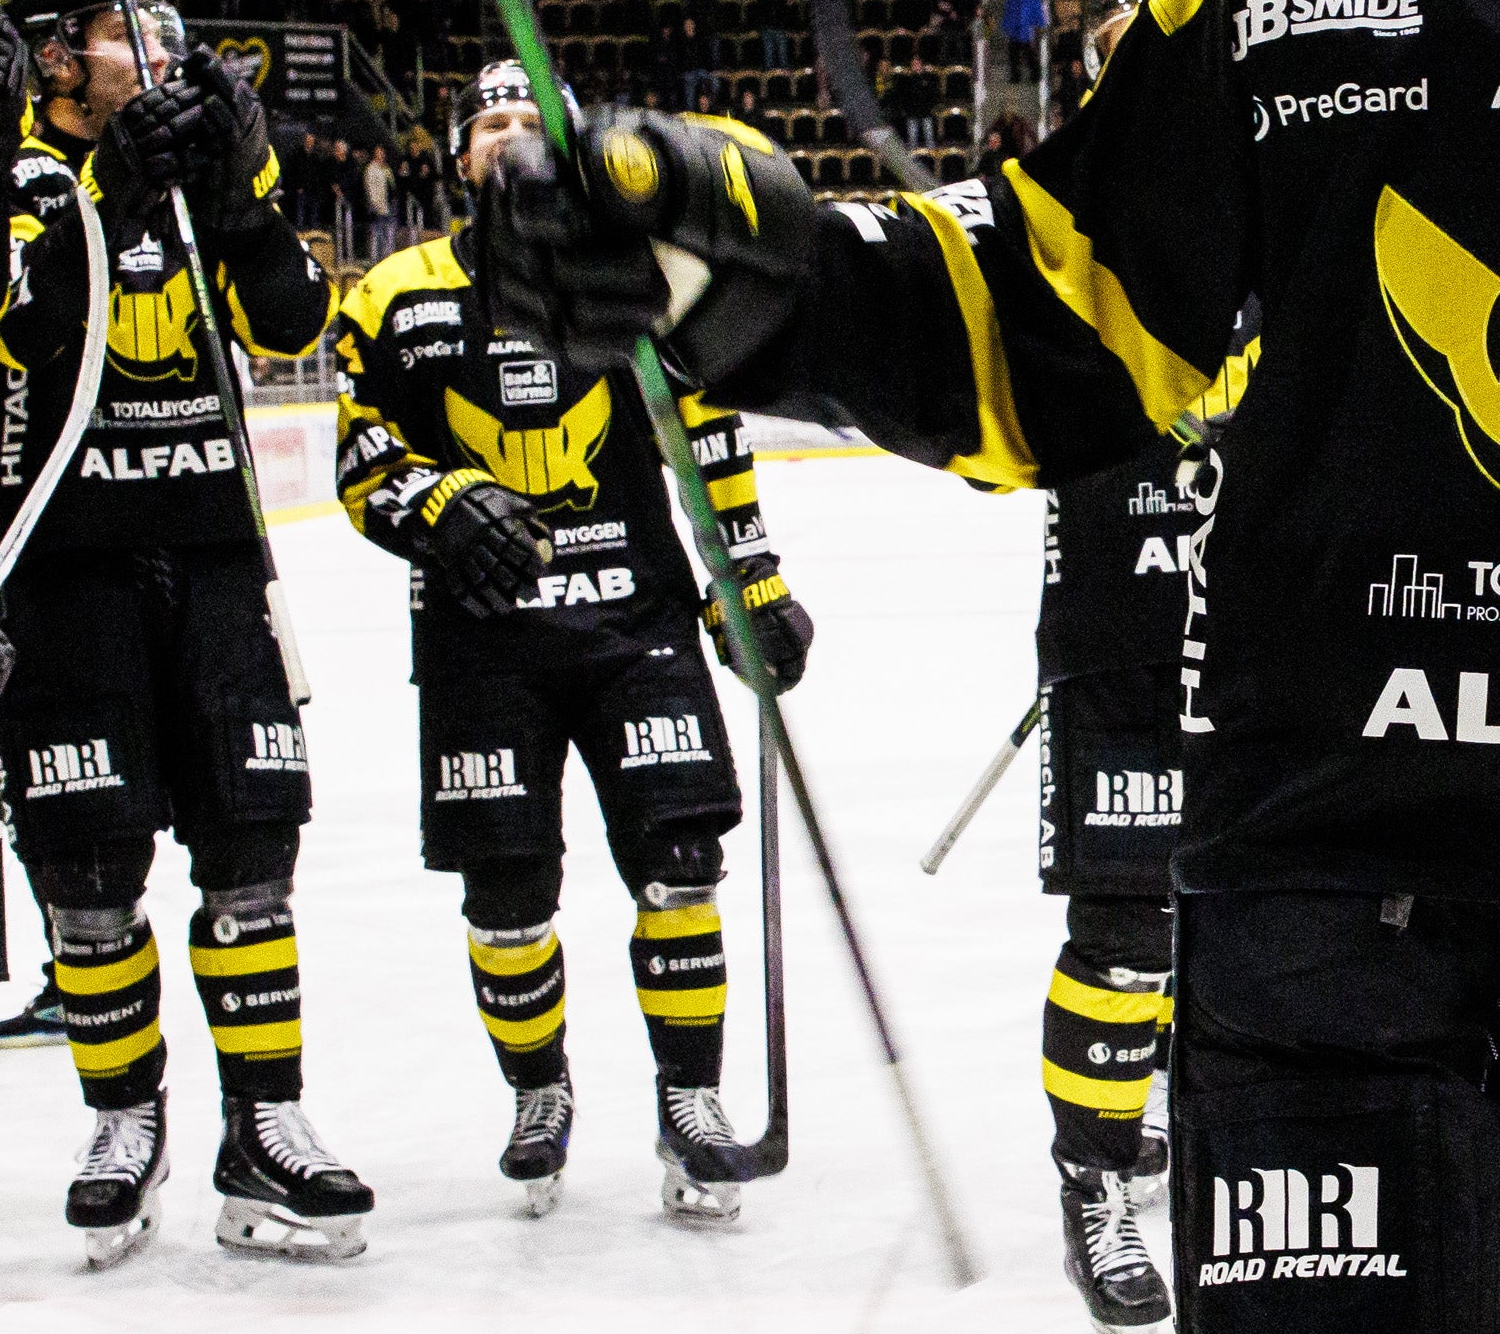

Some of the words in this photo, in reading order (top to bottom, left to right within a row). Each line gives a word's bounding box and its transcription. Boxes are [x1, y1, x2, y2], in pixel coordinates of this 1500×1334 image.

[1274, 77, 1430, 127] PreGard
[81, 439, 237, 481] ALFAB
[65, 773, 126, 794] RENTAL
[1199, 1255, 1267, 1289] ROAD
[1271, 1252, 1409, 1281] RENTAL
